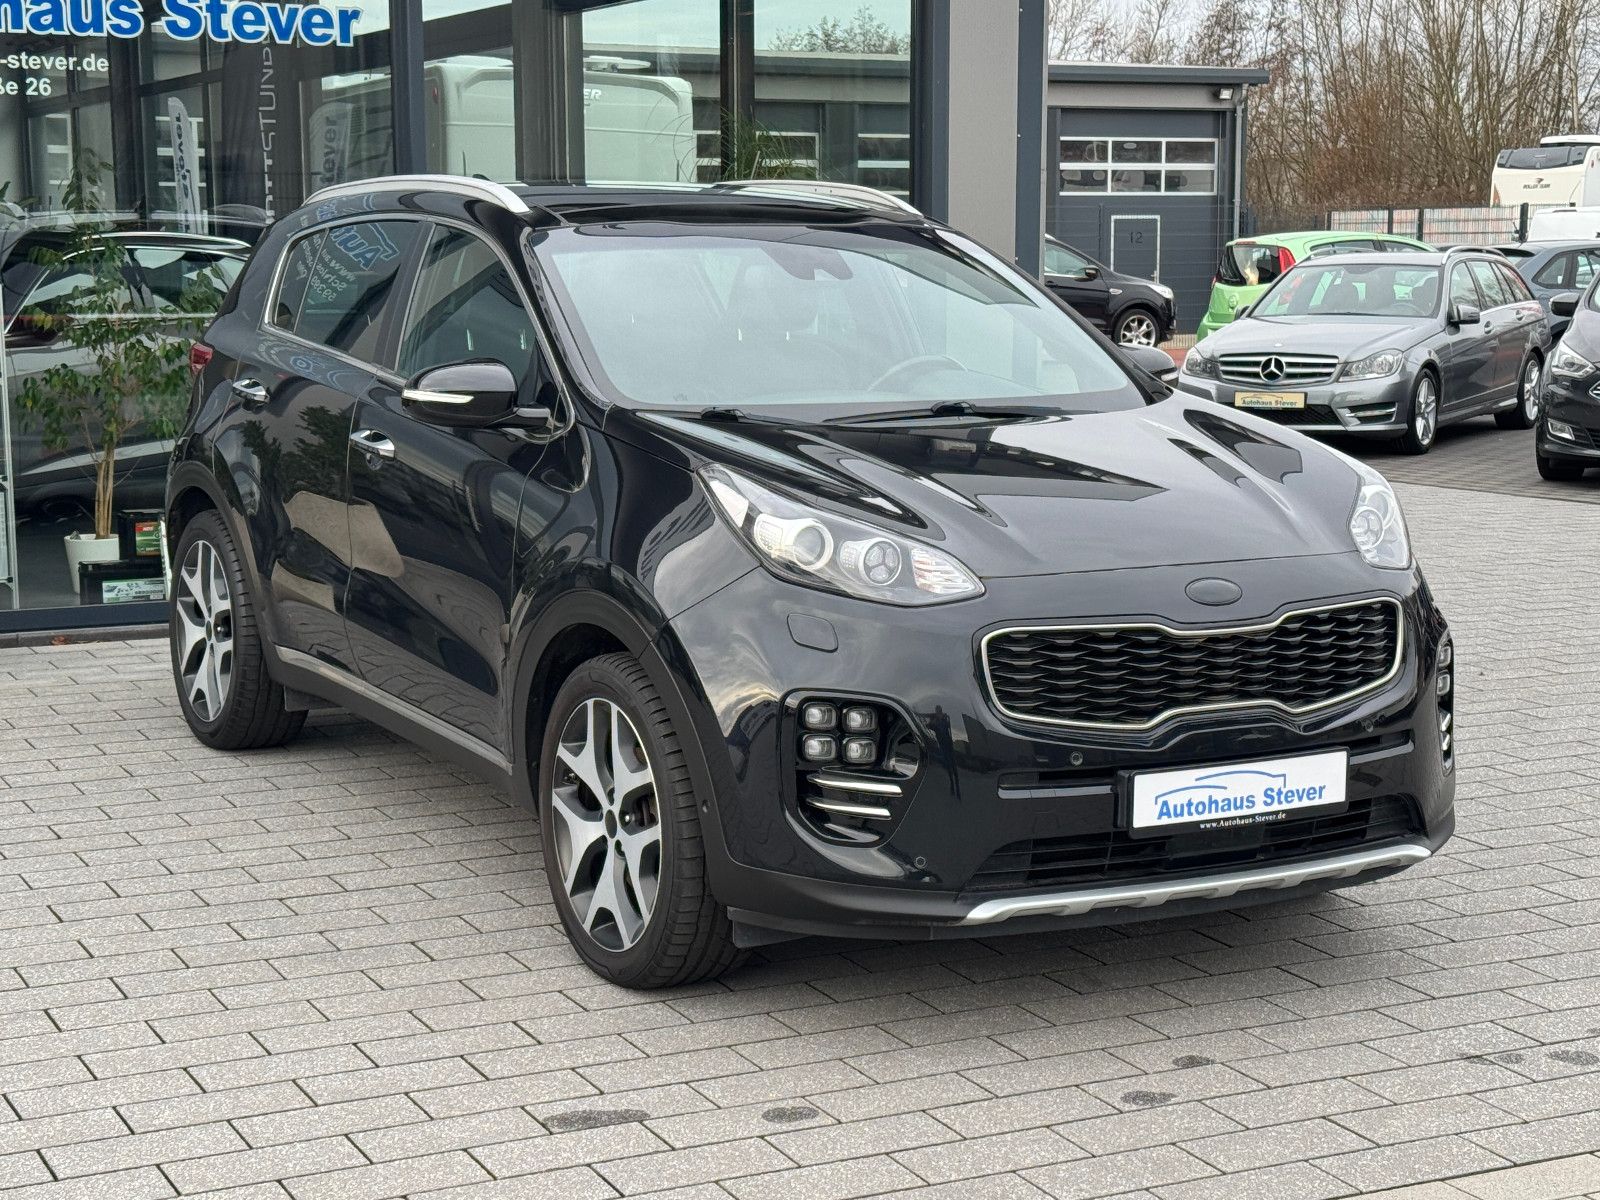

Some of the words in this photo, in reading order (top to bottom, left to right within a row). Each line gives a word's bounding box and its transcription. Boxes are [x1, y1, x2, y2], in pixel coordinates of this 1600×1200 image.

[161, 0, 363, 47] Stever
[25, 77, 52, 97] 26
[1130, 231, 1143, 244] 12
[1274, 399, 1298, 407] Stever
[1156, 793, 1256, 821] Autohaus
[1262, 784, 1327, 808] Stever
[1199, 811, 1287, 829] www.Autohaus-Stever.de
